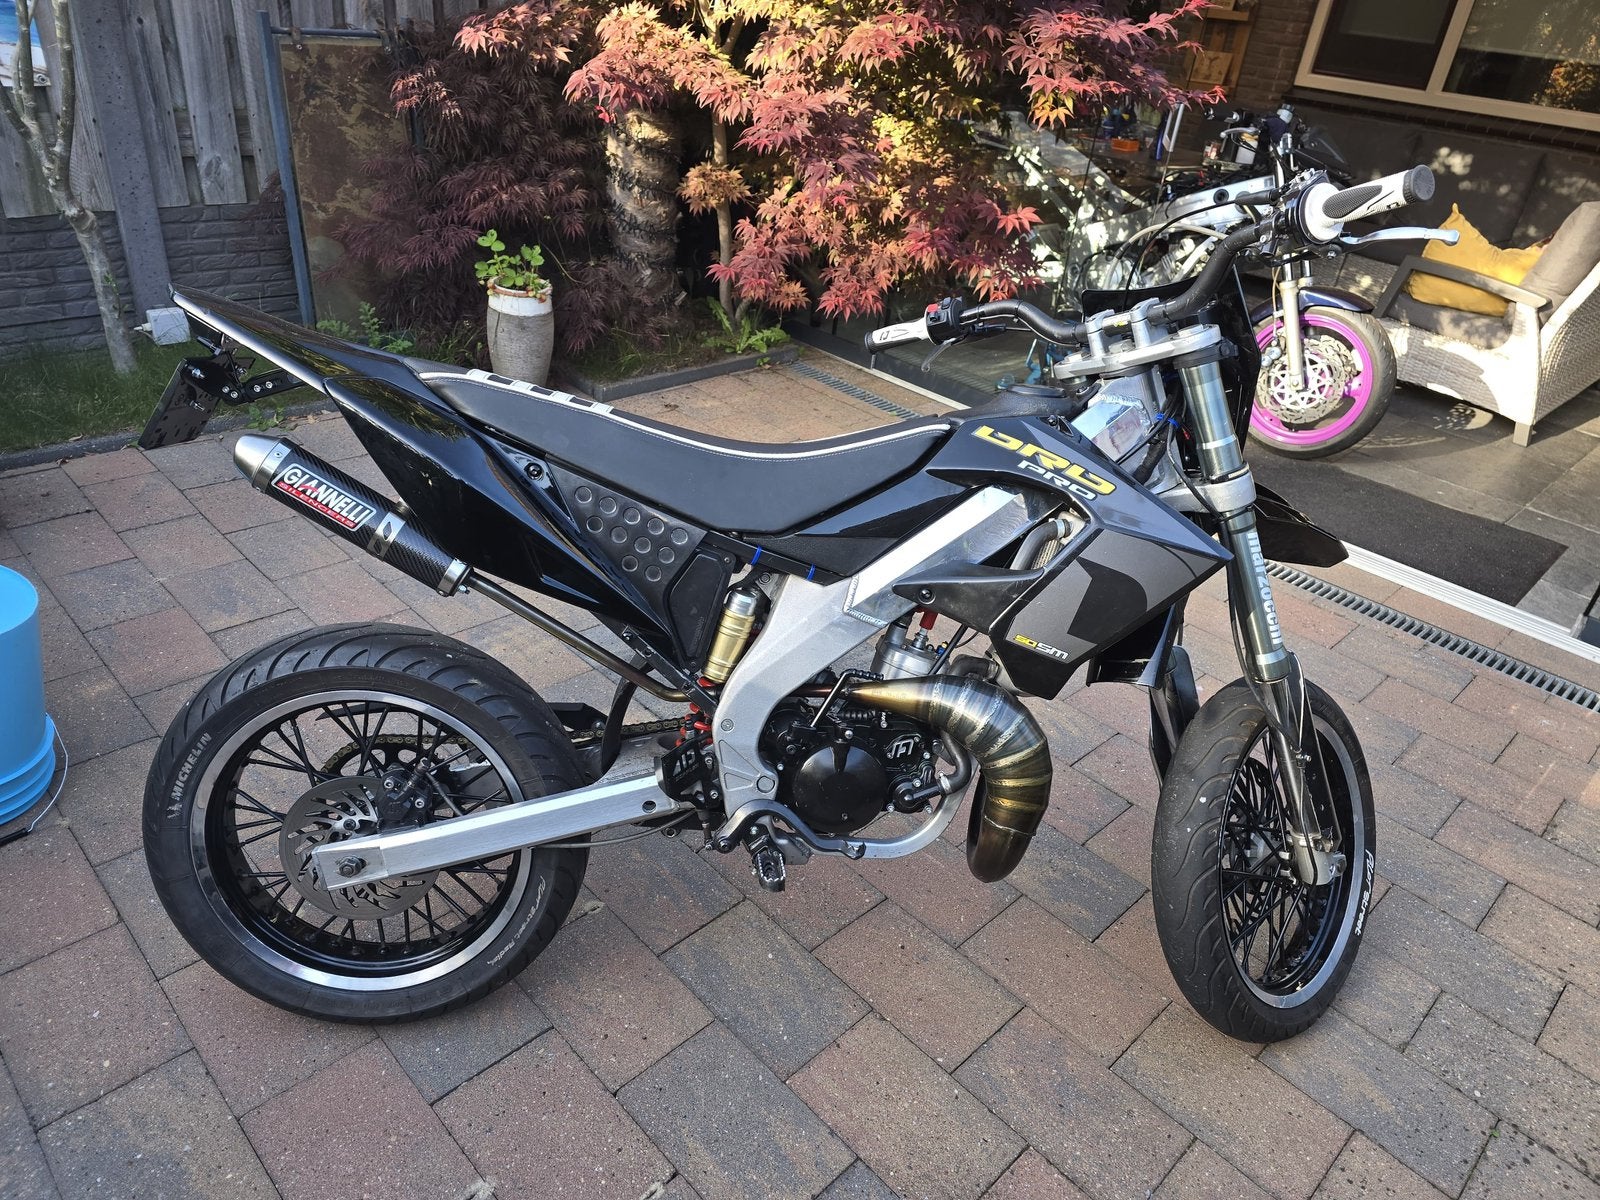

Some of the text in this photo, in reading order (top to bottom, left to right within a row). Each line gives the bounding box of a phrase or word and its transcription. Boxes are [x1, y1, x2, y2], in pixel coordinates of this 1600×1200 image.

[276, 481, 357, 529] SILENCERS
[283, 468, 371, 524] GIANNELLI
[1018, 460, 1097, 500] PRO
[1247, 532, 1282, 645] marzocchi
[171, 732, 212, 801] MICHELIN
